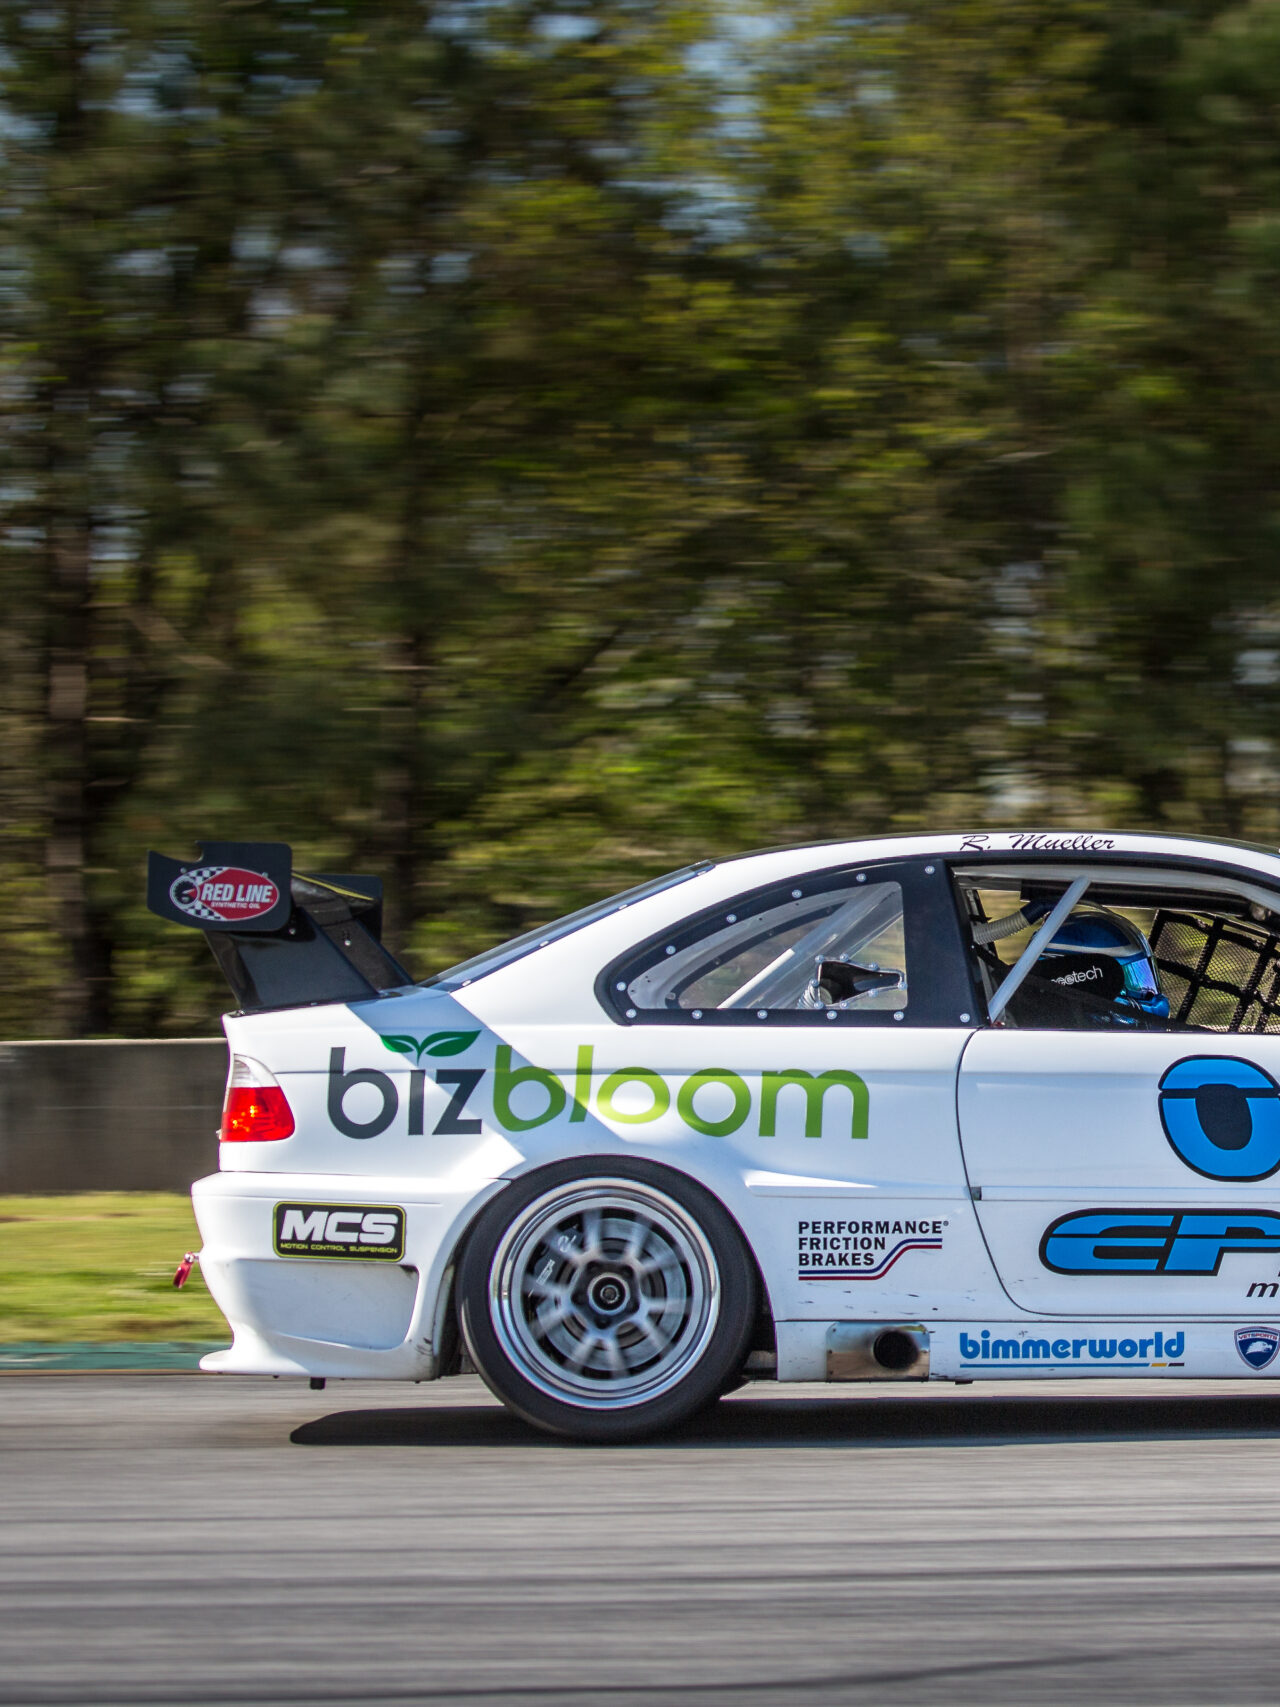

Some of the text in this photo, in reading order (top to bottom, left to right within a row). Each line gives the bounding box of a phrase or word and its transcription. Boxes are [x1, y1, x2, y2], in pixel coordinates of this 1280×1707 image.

[960, 833, 1115, 851] R. Mueller
[201, 883, 274, 903] RED LINE
[327, 1044, 870, 1141] bizbloom
[280, 1209, 398, 1244] MCS
[280, 1242, 398, 1254] MOTION CONTROL SUSPENSION
[798, 1237, 886, 1250] FRICTION
[798, 1253, 875, 1266] BRAKES
[959, 1329, 1185, 1359] bimmerworld
